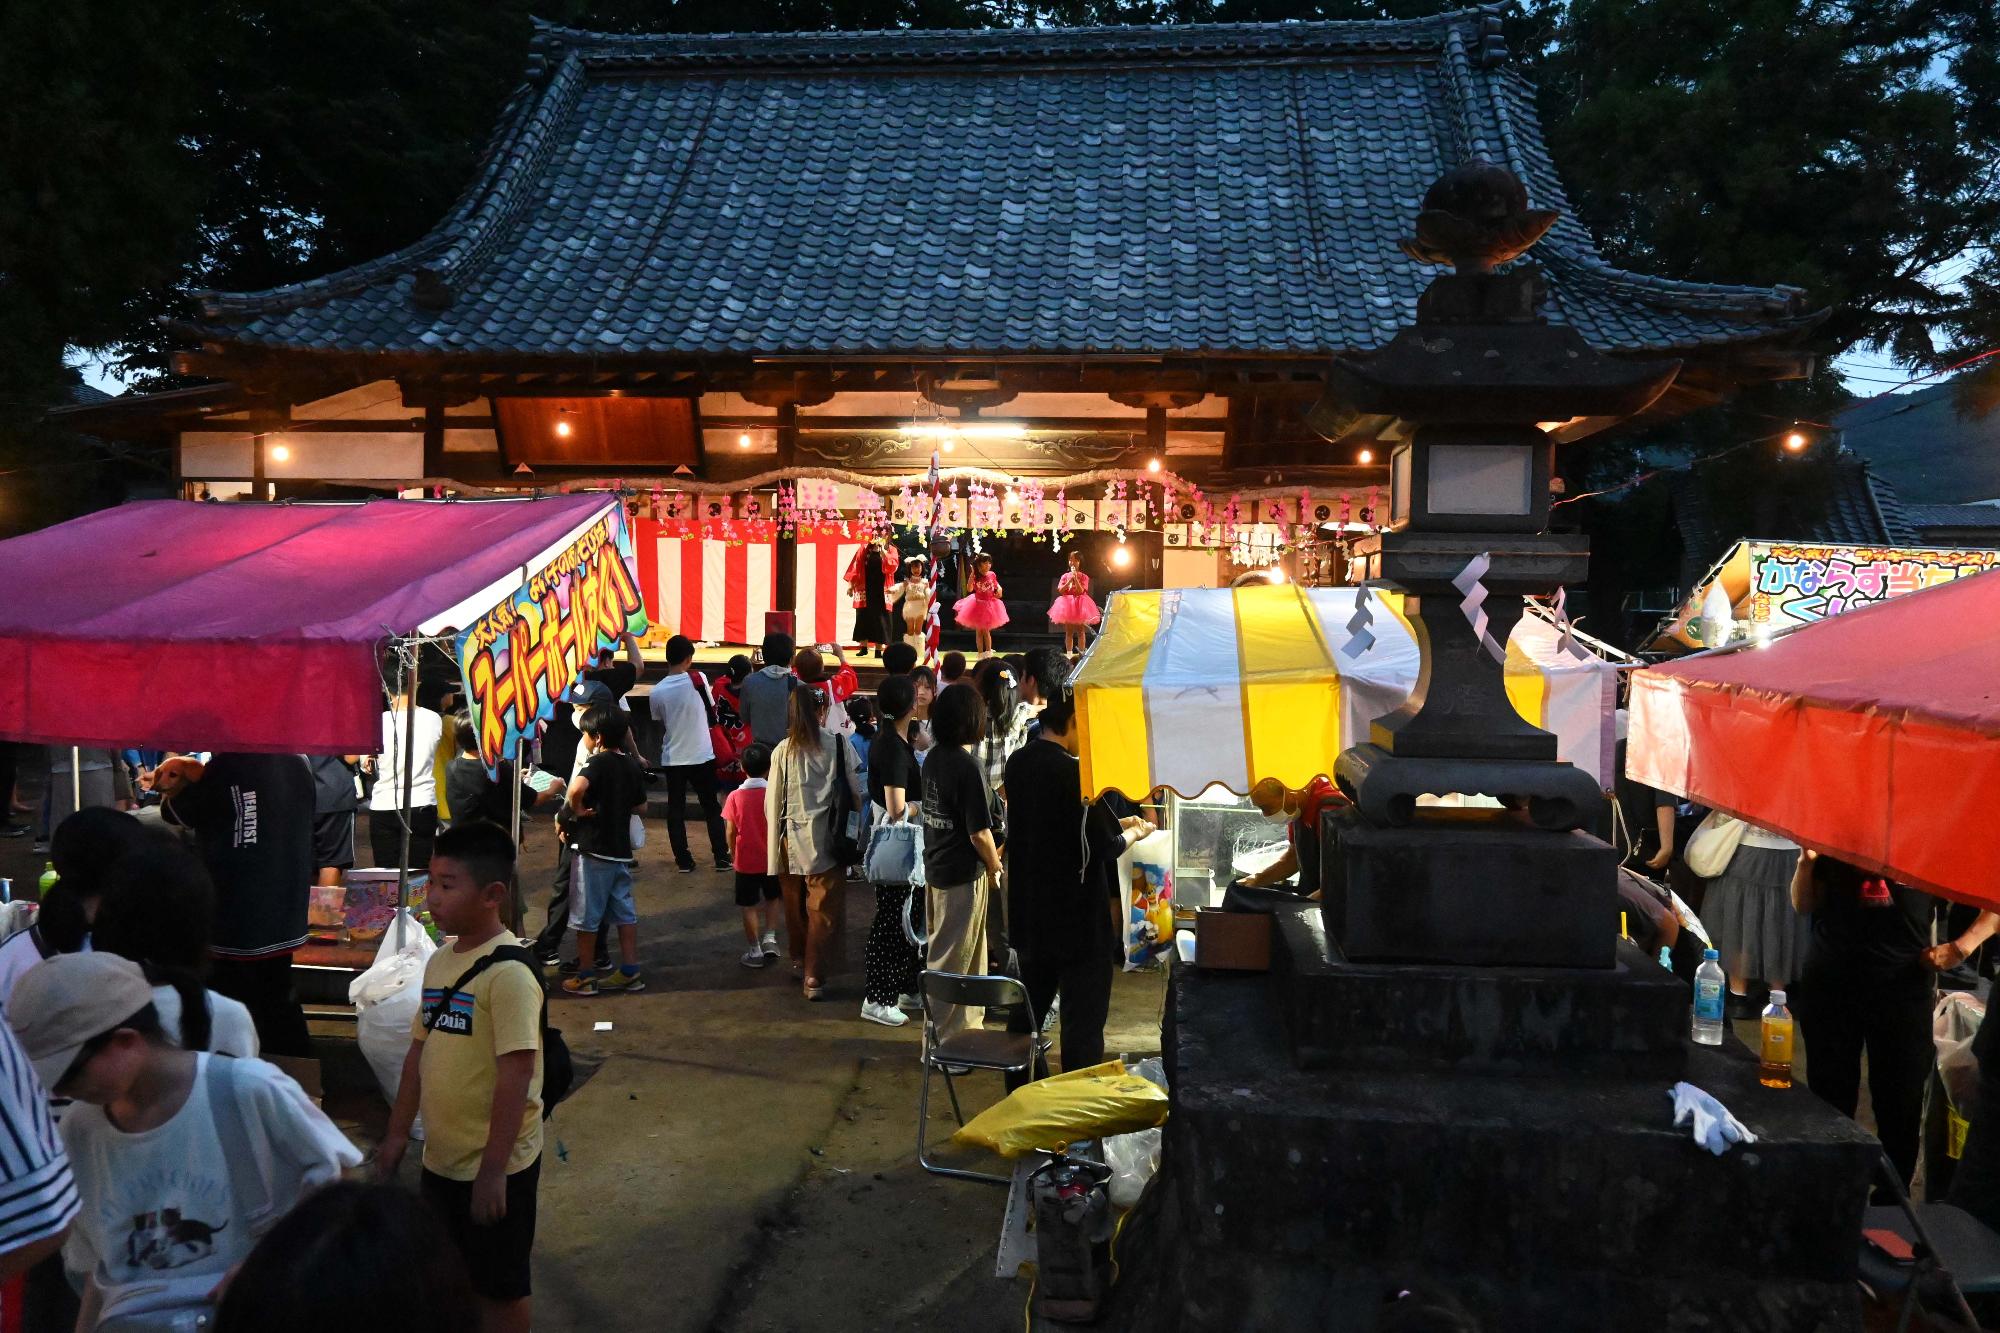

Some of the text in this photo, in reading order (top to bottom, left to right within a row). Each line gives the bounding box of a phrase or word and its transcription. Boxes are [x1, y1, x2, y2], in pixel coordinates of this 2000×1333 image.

[471, 545, 640, 766] スーパーボールすくい
